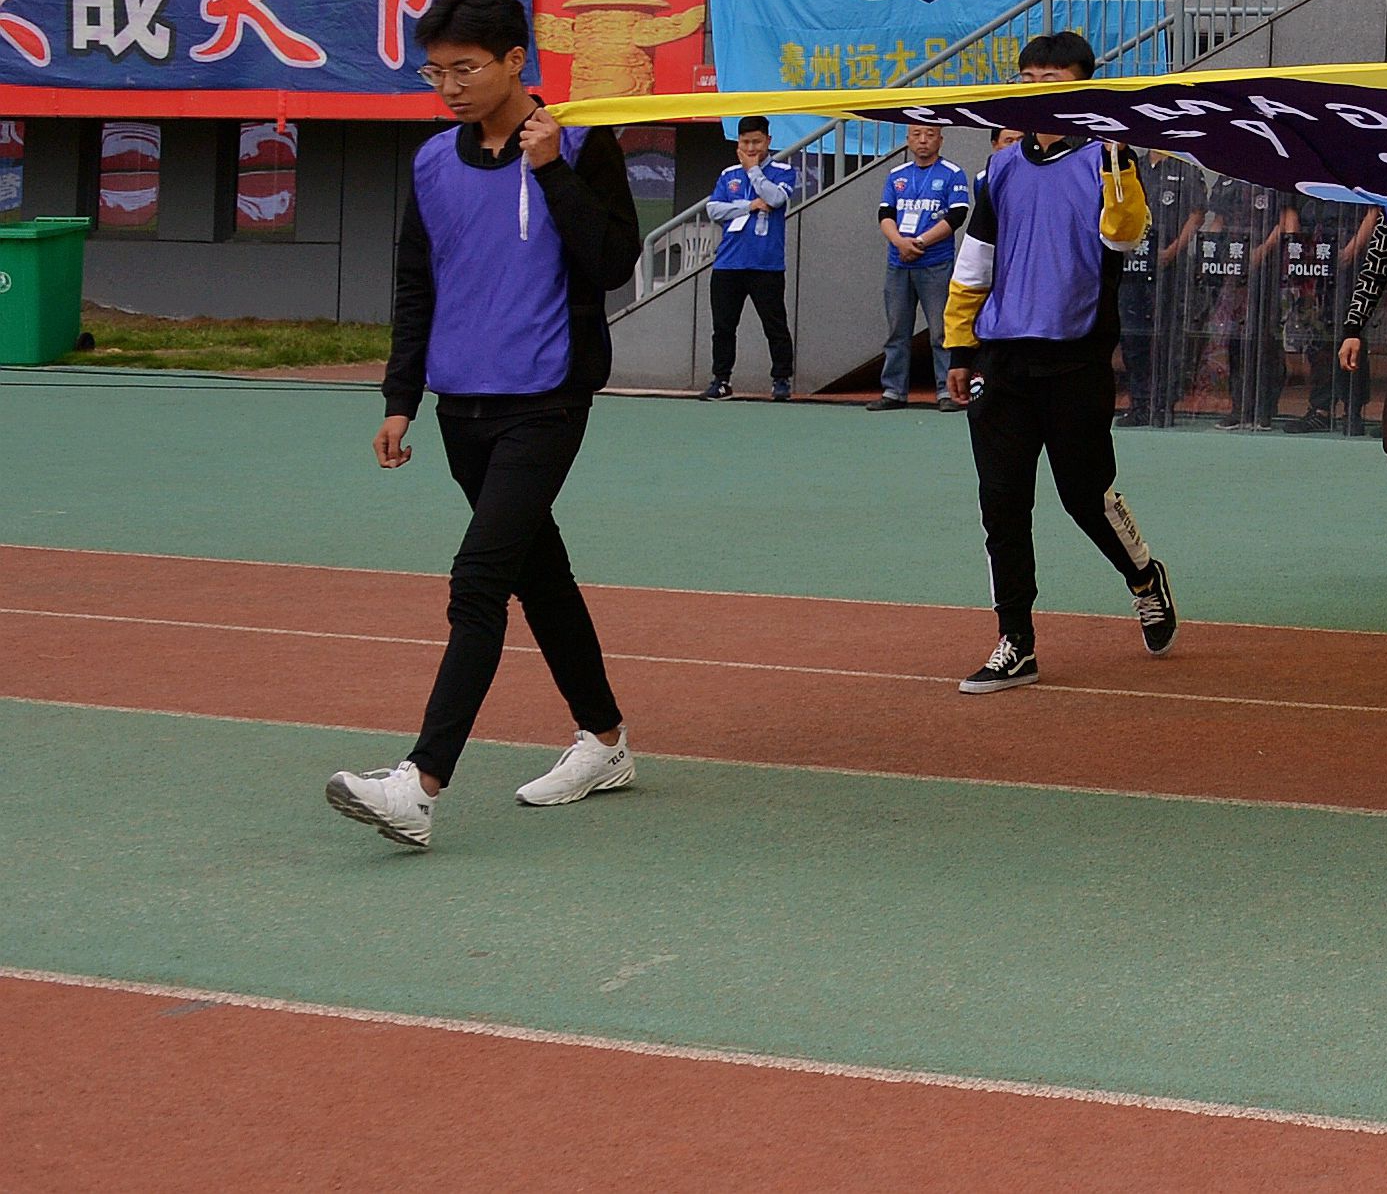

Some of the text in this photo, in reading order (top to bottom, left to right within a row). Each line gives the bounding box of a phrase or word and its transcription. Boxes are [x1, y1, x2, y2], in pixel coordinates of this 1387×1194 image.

[1202, 241, 1244, 259] 警察
[1287, 241, 1331, 259] 警察
[1201, 262, 1242, 276] POLICE
[1287, 262, 1330, 278] POLICE
